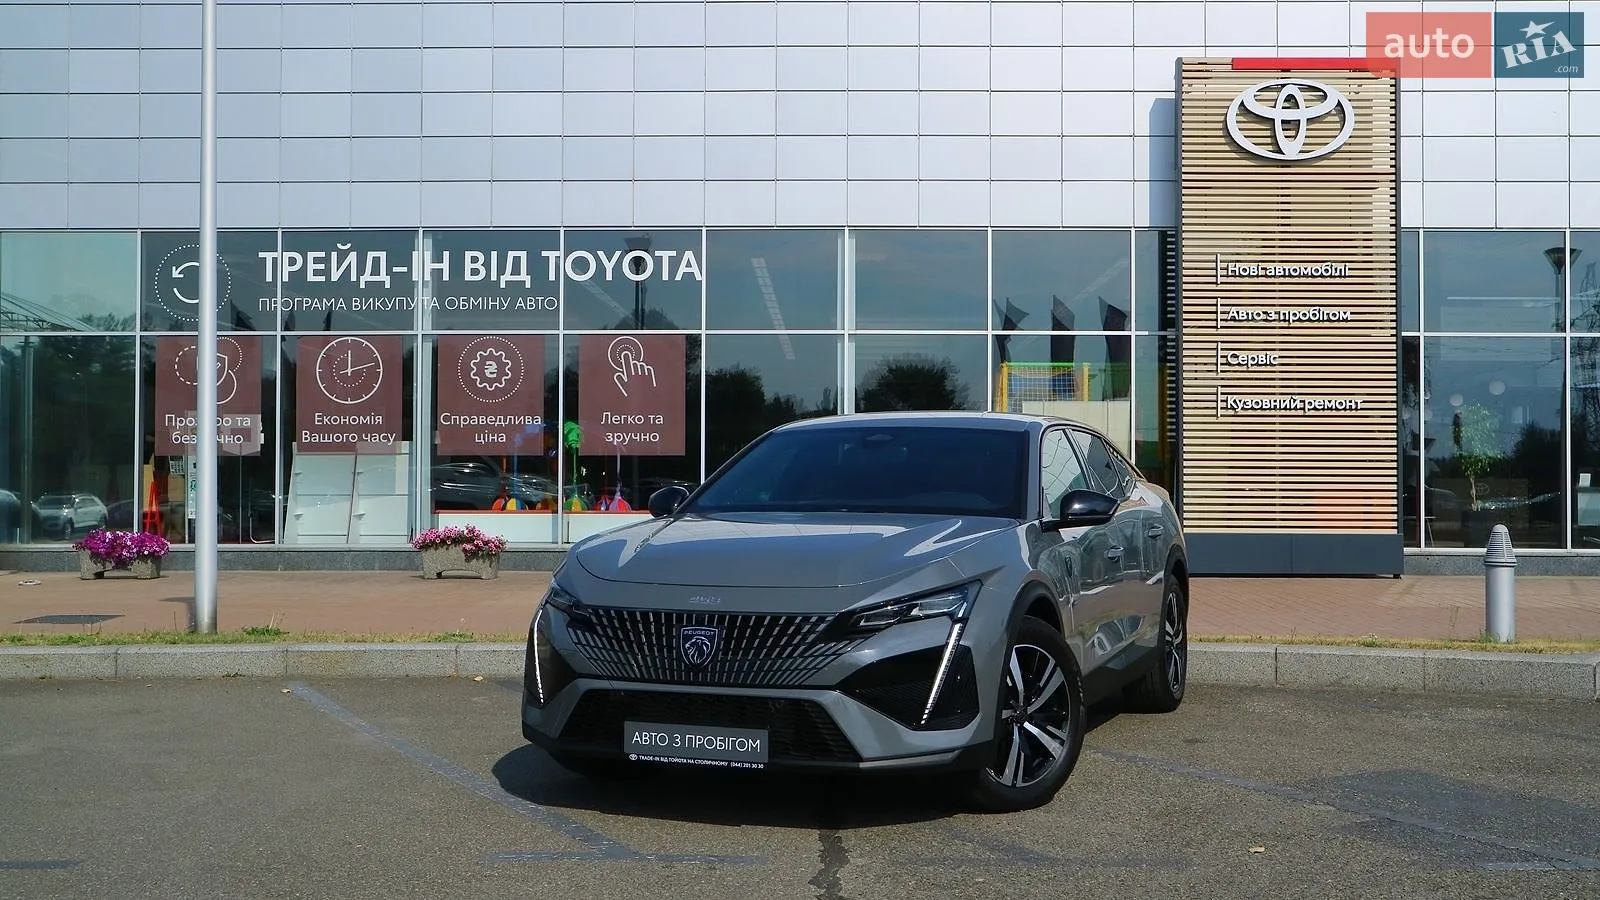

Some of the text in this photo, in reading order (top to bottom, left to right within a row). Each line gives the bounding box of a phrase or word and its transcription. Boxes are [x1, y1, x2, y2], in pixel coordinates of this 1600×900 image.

[258, 243, 703, 288] ТРЕЙД-ІН ВІД TOYOTA
[1227, 262, 1349, 276] Нові автомобілі
[259, 296, 558, 312] ПРОГРАМА ВИКУПУ ТА ОБМІНУ АВТО
[1227, 306, 1351, 323] Авто з пробігом
[1227, 351, 1278, 368] Сервіс
[1227, 395, 1363, 412] Кузовний ремонт
[165, 414, 251, 429] Проо та
[314, 412, 383, 425] Економія
[440, 412, 542, 428] Справедлива
[601, 412, 664, 425] Легко та
[171, 431, 244, 444] безчно
[302, 430, 396, 446] Вашого часу
[475, 430, 507, 444] ціна
[605, 432, 660, 446] зручно
[631, 731, 761, 753] АВТО З ПРОБІГОМ
